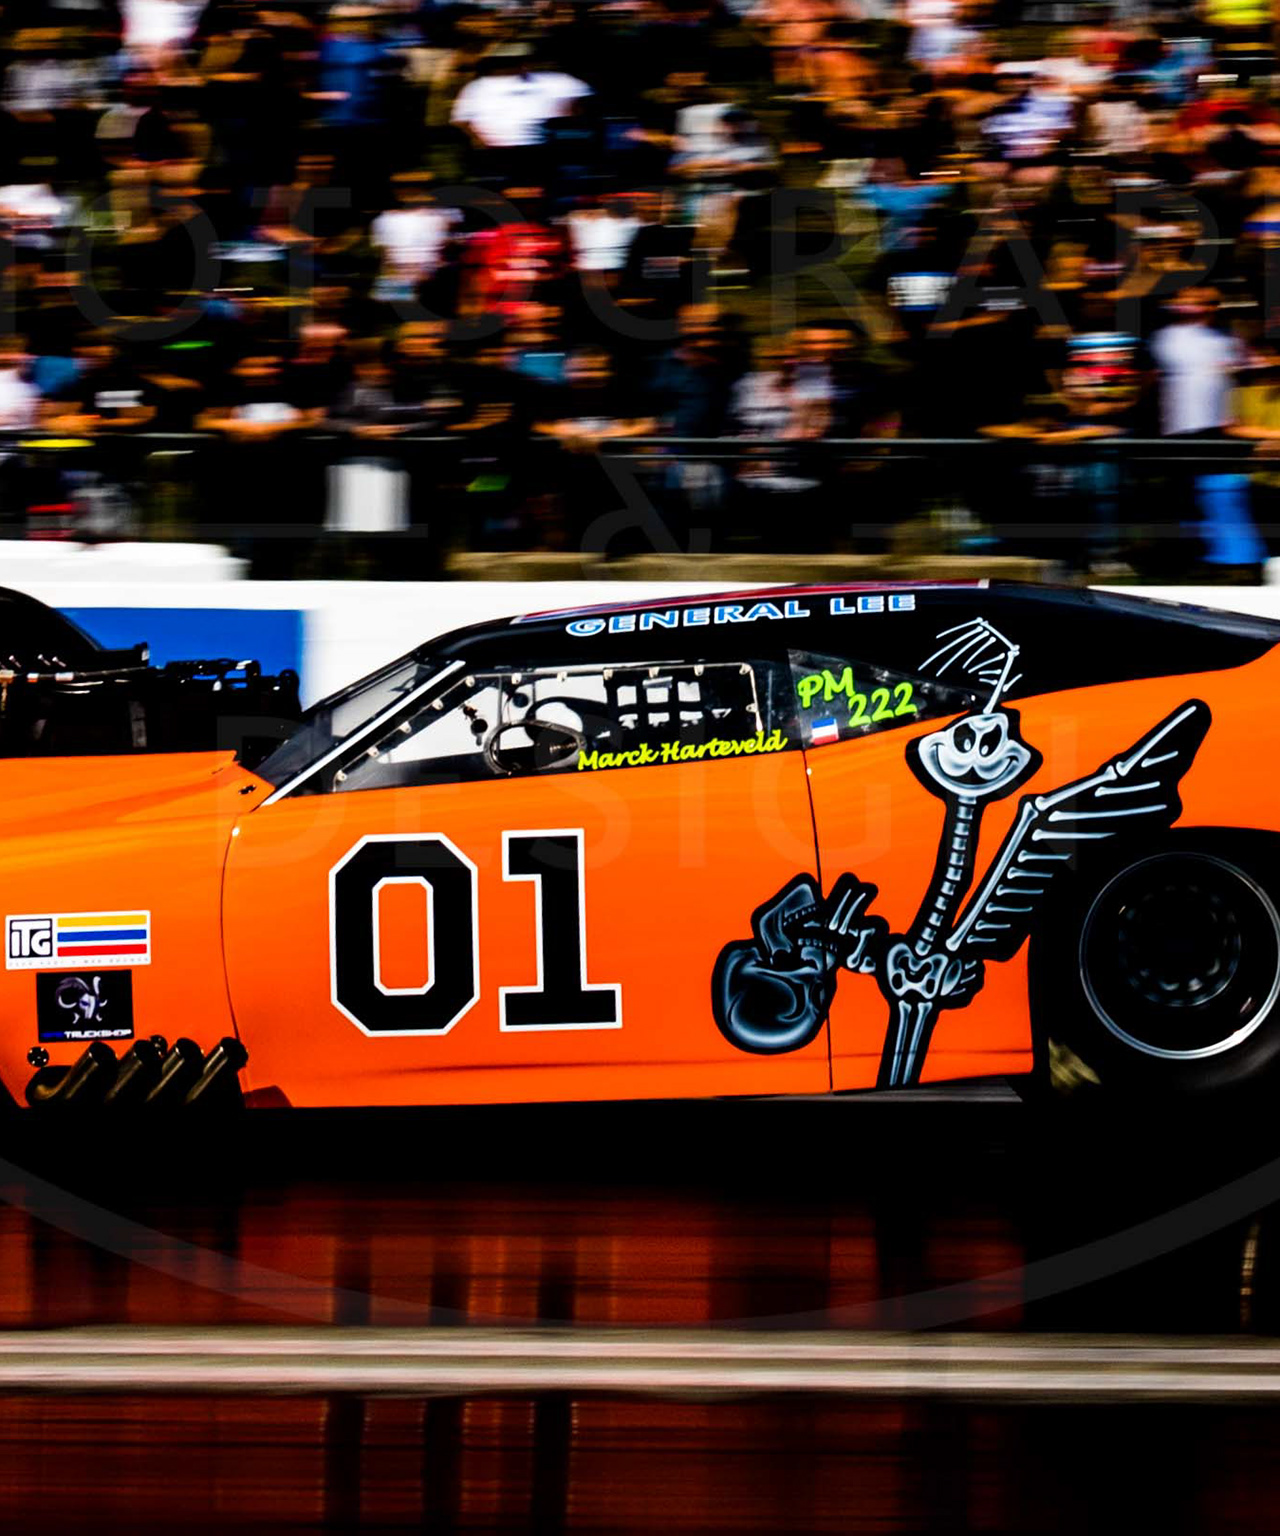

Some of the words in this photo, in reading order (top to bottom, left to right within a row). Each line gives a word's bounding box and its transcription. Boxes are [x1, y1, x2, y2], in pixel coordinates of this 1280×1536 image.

[565, 598, 810, 637] GENERAL
[829, 593, 916, 615] LEE
[797, 666, 855, 709] PM
[847, 682, 918, 728] 222
[577, 744, 660, 771] Marck
[661, 729, 789, 765] Harteveld
[328, 827, 623, 1038] 01
